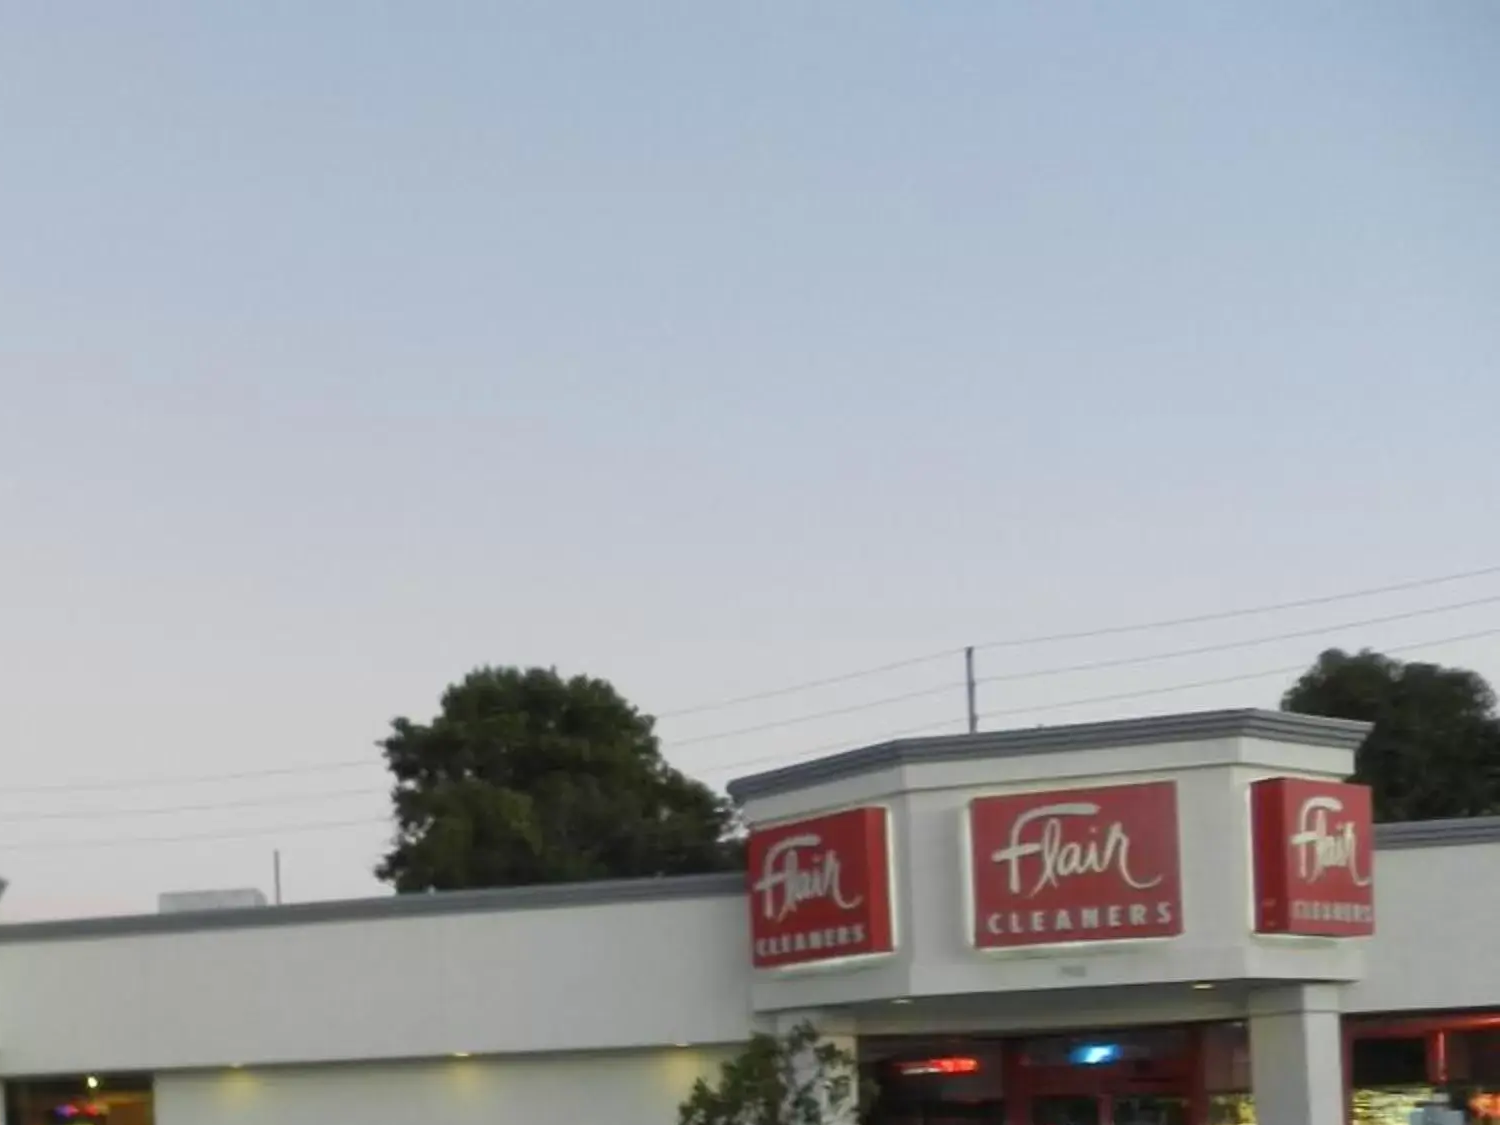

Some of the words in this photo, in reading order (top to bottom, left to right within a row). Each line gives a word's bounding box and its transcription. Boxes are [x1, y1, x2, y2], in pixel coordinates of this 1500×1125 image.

[754, 833, 864, 924] Flair
[991, 802, 1165, 899] Flair
[755, 923, 867, 957] CLEANERS
[987, 902, 1173, 934] CLEANERS
